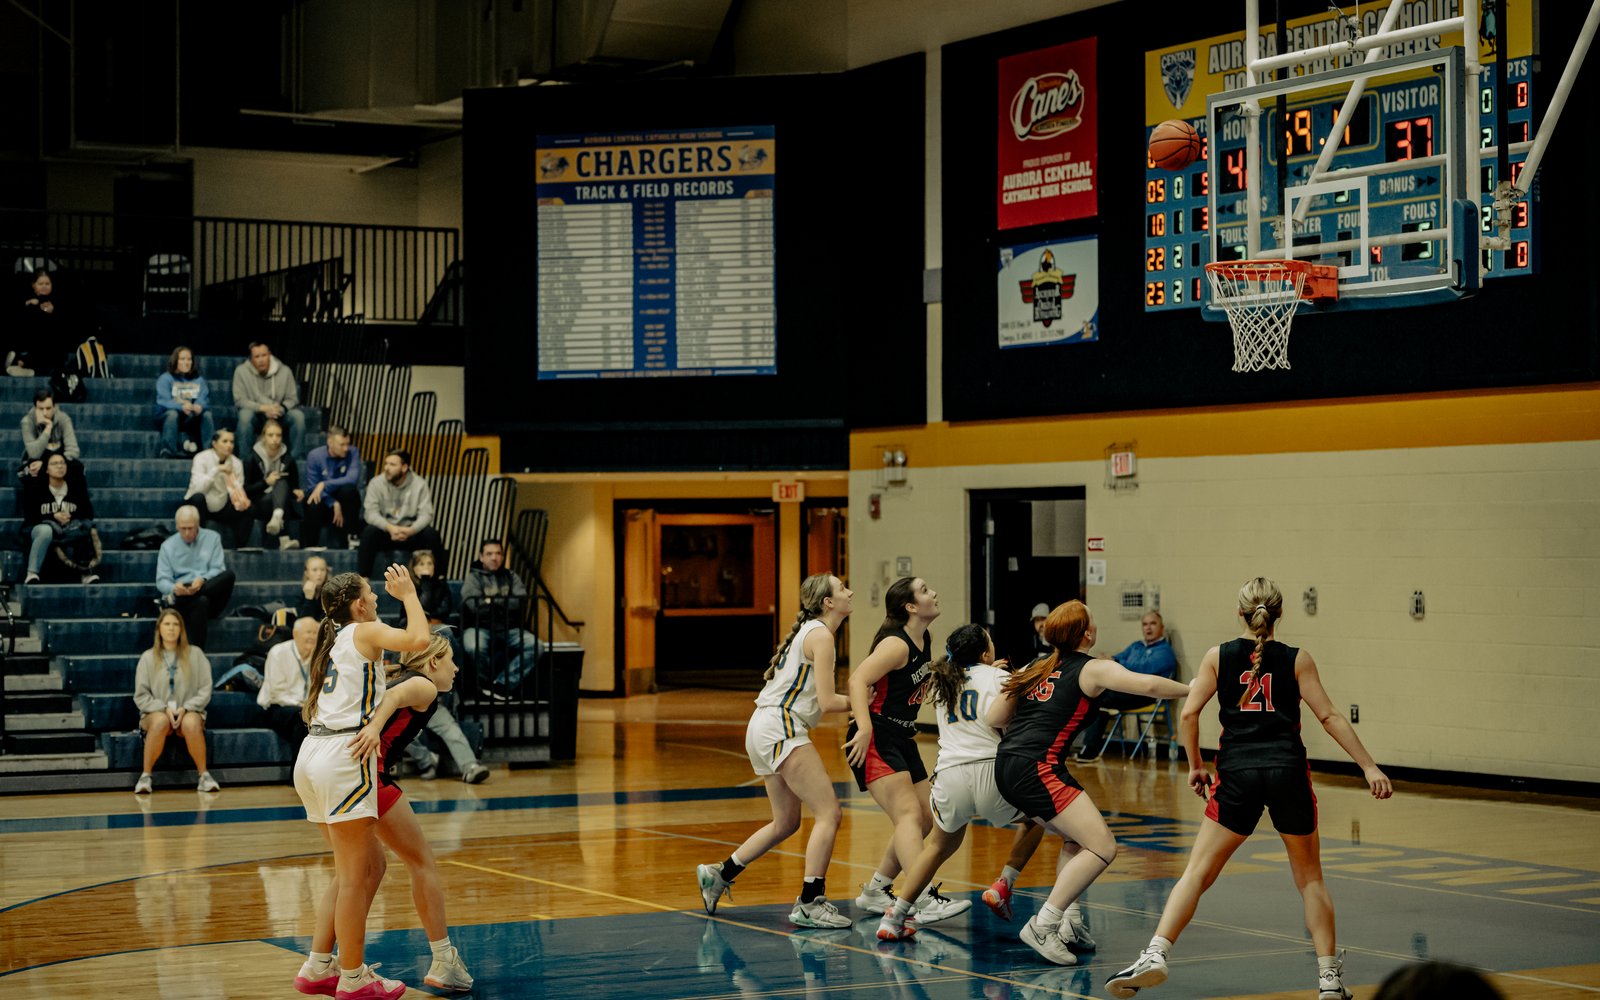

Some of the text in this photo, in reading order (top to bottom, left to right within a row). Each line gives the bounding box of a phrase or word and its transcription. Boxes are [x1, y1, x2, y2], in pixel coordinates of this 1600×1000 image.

[1381, 84, 1438, 113] VISITOR
[1516, 82, 1528, 108] 0
[1394, 116, 1432, 161] 37
[576, 145, 732, 177] CHARGERS
[1002, 160, 1093, 191] AURORA CENTRAL
[1061, 177, 1093, 195] SCHOOL
[1173, 176, 1183, 199] 0
[1379, 175, 1415, 195] BONUS
[575, 184, 615, 200] TRACK
[619, 184, 629, 199] &
[633, 183, 669, 198] FIELD
[673, 180, 734, 197] RECORDS
[1147, 179, 1165, 203] 05
[1151, 212, 1165, 236] 10
[1403, 203, 1437, 221] FOULS
[1481, 206, 1492, 232] 2
[1516, 202, 1528, 228] 3
[1147, 247, 1165, 271] 22
[1173, 245, 1183, 268] 2
[1516, 241, 1528, 267] 0
[1173, 280, 1183, 303] 2
[41, 502, 58, 515] OLD
[1239, 670, 1276, 712] 21
